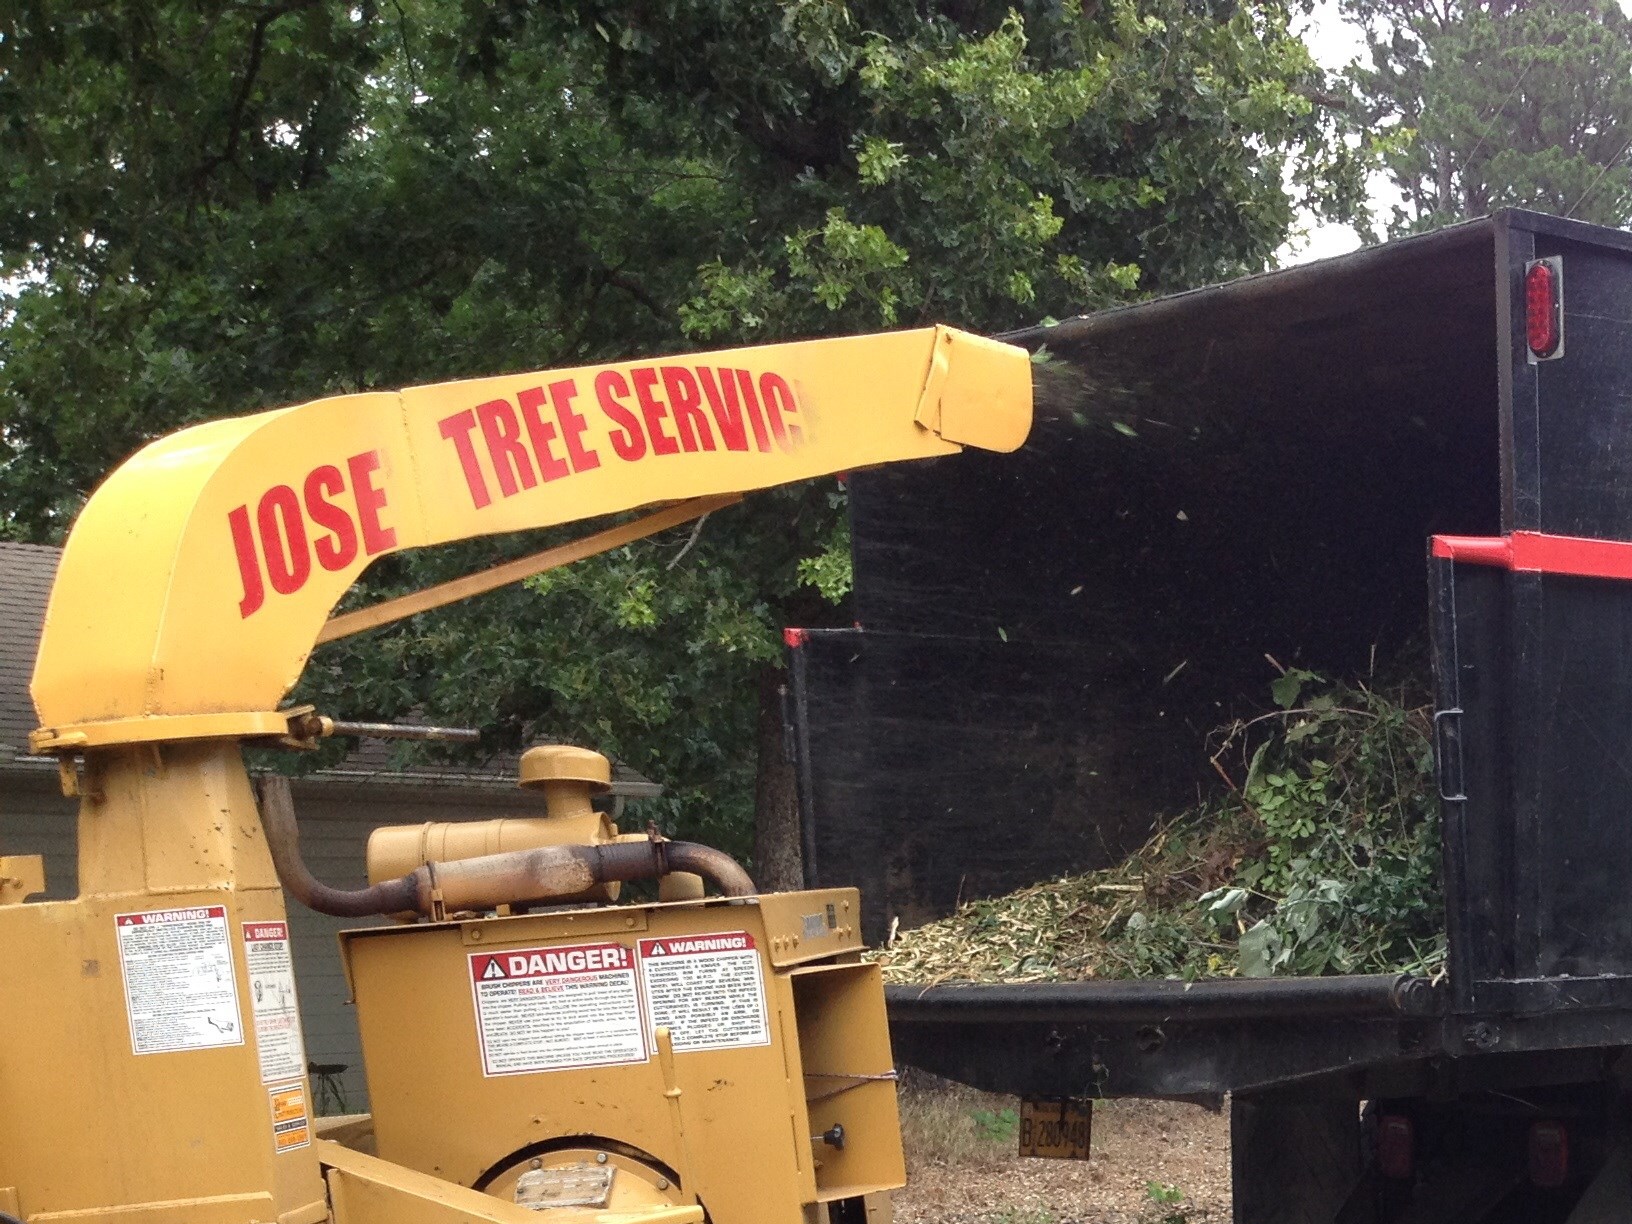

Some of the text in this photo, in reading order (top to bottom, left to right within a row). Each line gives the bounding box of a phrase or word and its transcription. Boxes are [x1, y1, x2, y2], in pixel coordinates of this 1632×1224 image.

[439, 375, 600, 510] TREE
[593, 365, 806, 464] SERVIC
[141, 909, 210, 924] WARNING!
[669, 938, 747, 954] WARNING!
[508, 947, 628, 977] DANGER!
